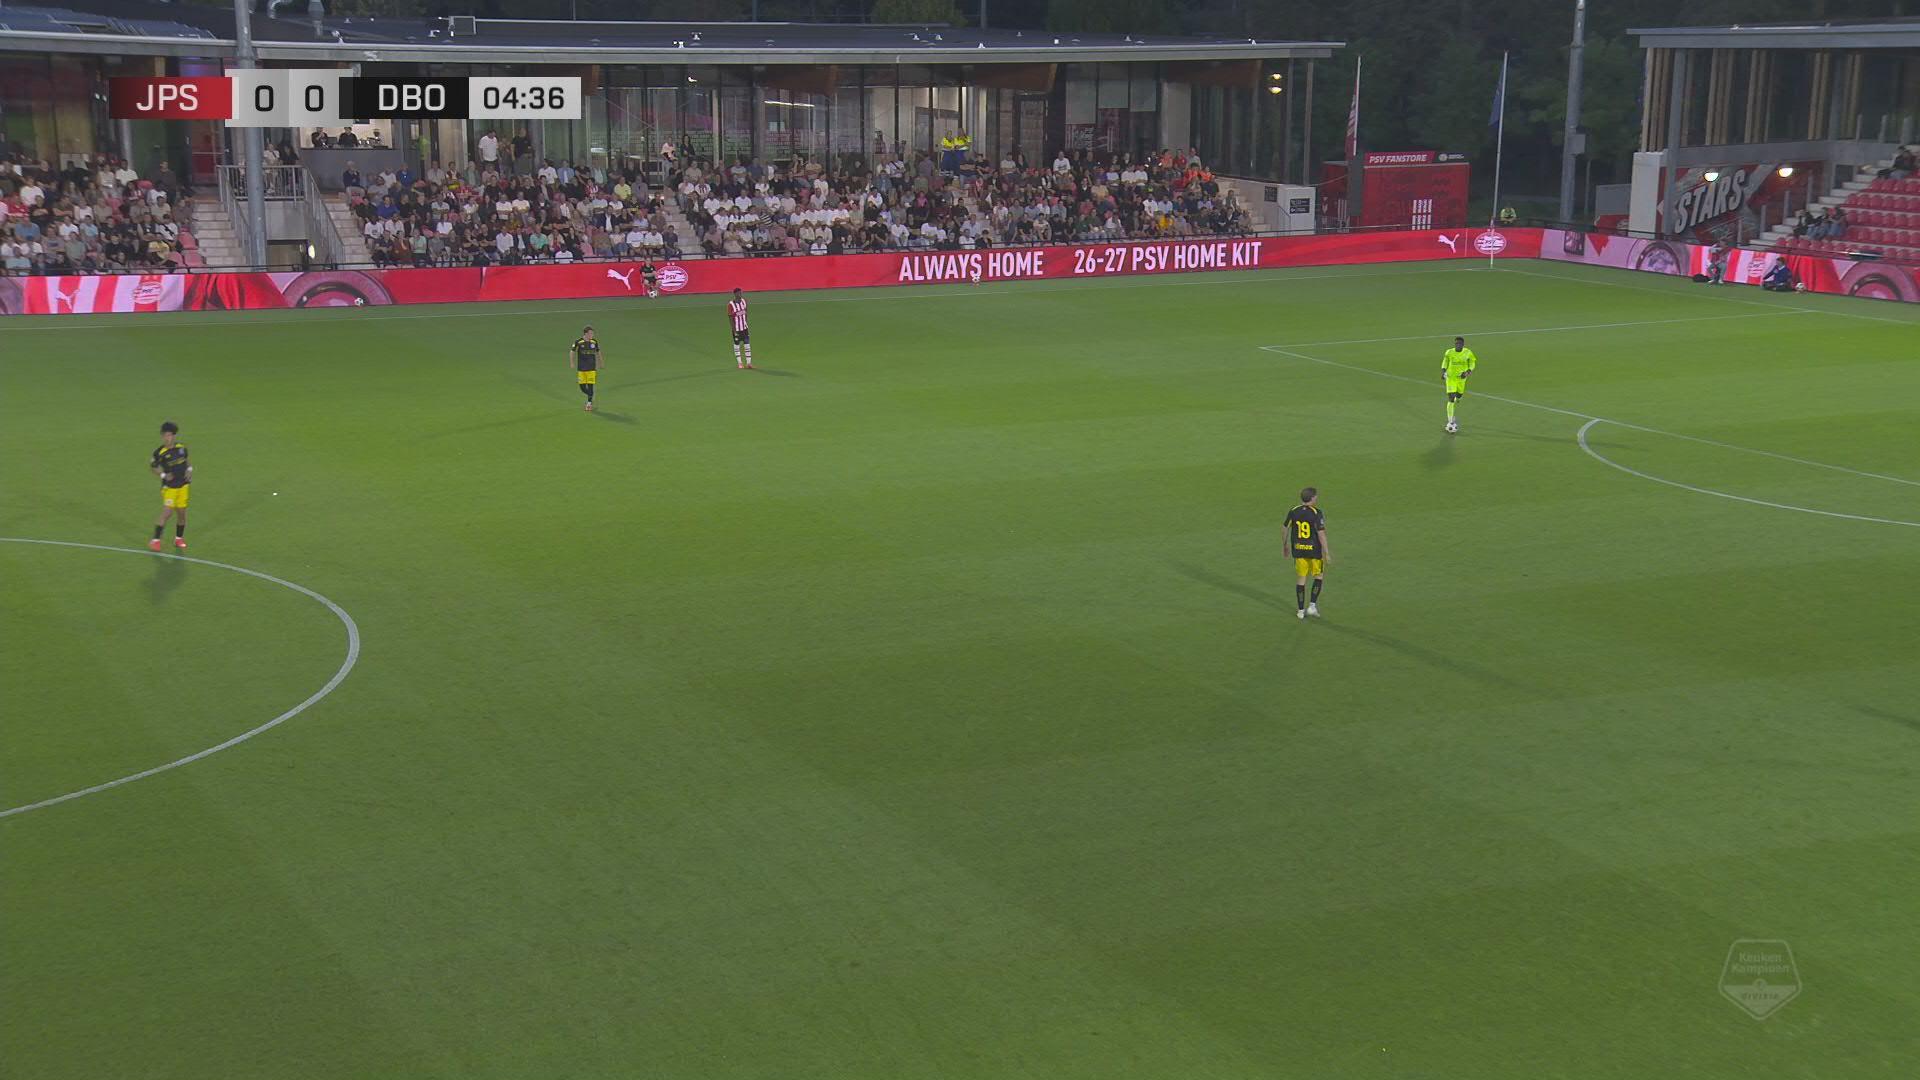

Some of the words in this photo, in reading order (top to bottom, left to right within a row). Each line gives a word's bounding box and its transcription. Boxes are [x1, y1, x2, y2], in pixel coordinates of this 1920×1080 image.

[1369, 155, 1386, 164] PSV
[1386, 154, 1427, 164] FANSTORE
[1674, 169, 1745, 234] STARS
[899, 253, 982, 281] ALWAYS
[988, 251, 1044, 278] HOME
[1073, 247, 1127, 274] 26-27
[1132, 246, 1170, 271] PSV
[1174, 243, 1227, 269] HOME
[1232, 241, 1262, 266] KIT
[1296, 520, 1311, 539] 19
